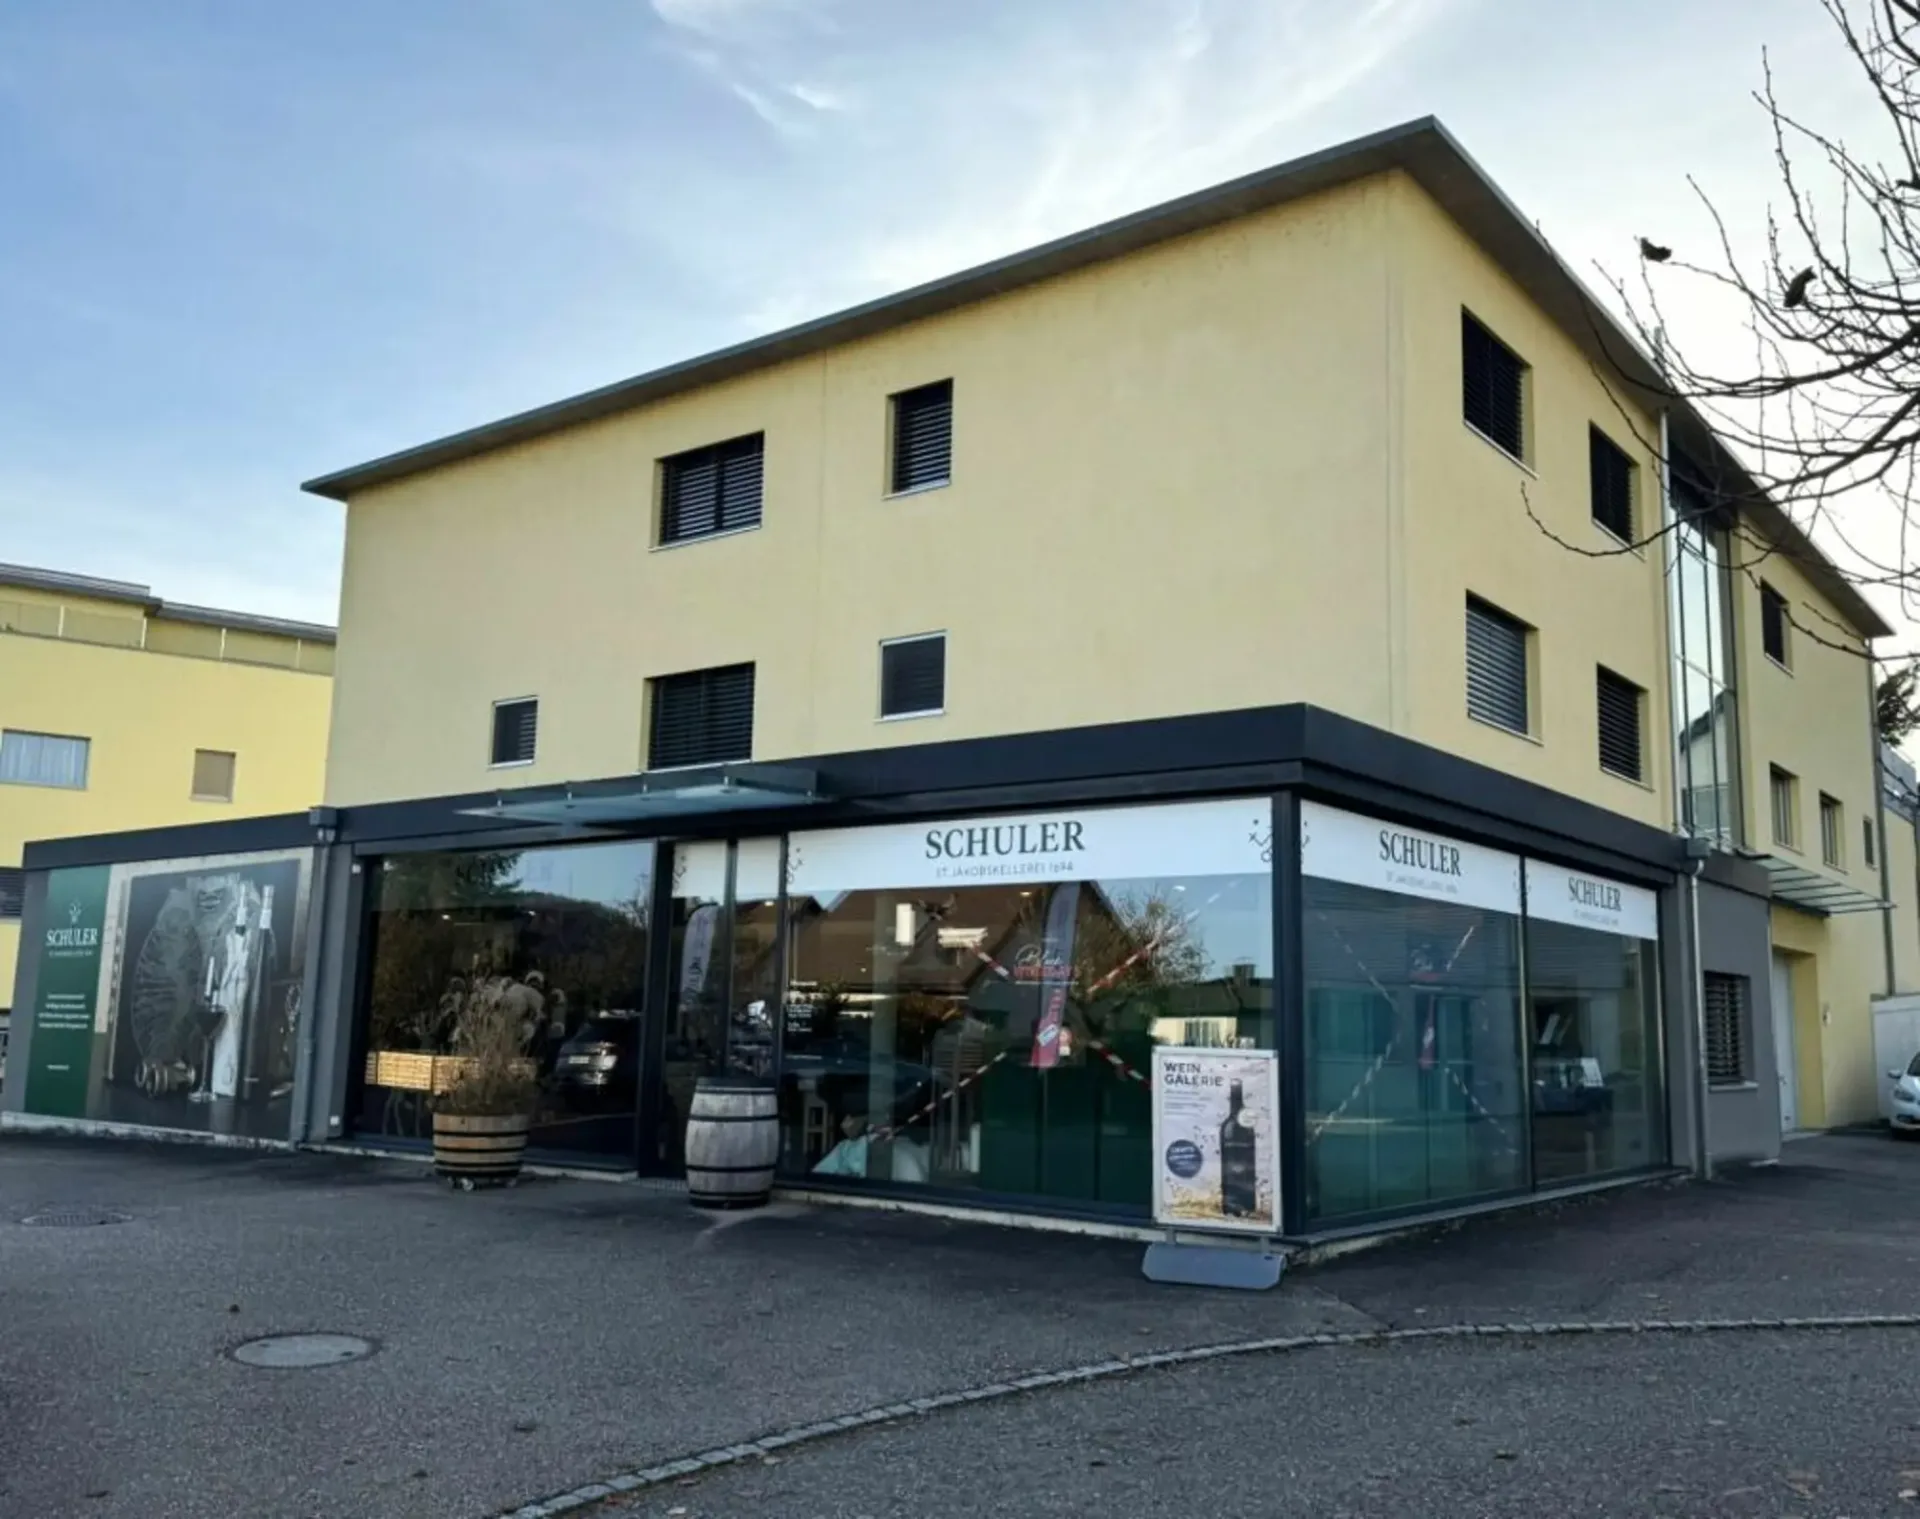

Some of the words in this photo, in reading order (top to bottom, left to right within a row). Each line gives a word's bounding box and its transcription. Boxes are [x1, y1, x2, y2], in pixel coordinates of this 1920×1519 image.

[925, 821, 1085, 859] SCHULER
[1379, 829, 1461, 877] SCHULER
[1568, 876, 1621, 911] SCHULER
[46, 927, 98, 946] SCHULER
[1164, 1062, 1201, 1074] WEIN
[1164, 1074, 1223, 1087] GALERIE
